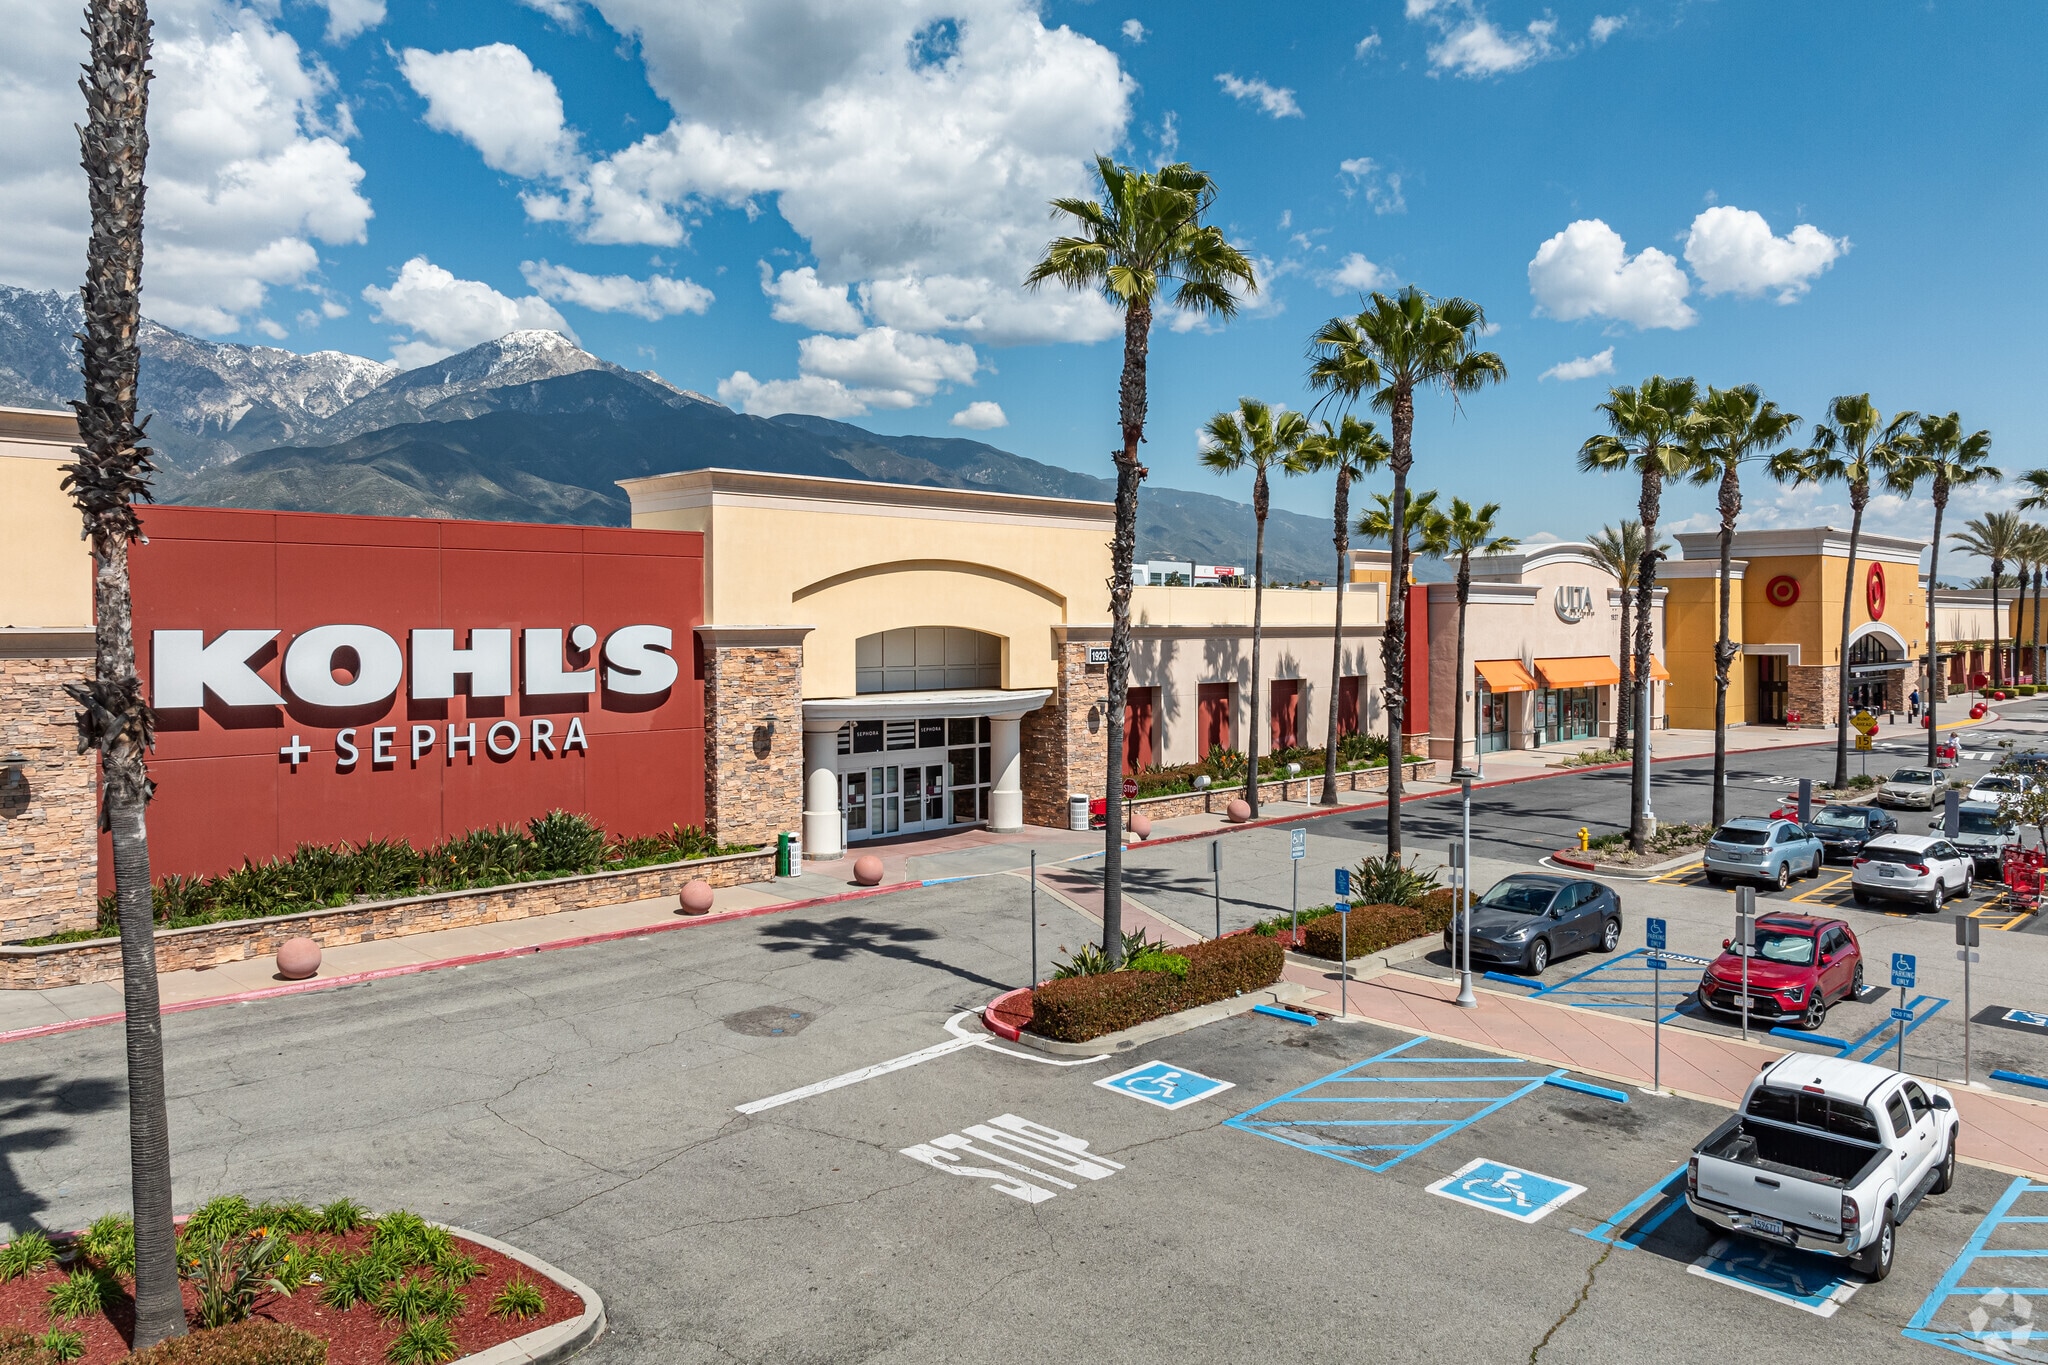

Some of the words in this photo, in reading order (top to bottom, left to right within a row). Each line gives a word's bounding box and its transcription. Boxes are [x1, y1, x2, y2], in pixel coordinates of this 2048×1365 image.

[1555, 585, 1593, 612] ULTA
[1092, 651, 1107, 661] 1923
[153, 624, 679, 709] KOHL'S
[336, 717, 588, 766] SEPHORA
[1858, 737, 1869, 745] 15
[1123, 784, 1137, 793] STOP
[1647, 933, 1665, 941] PARKING
[1892, 970, 1914, 979] PARKING
